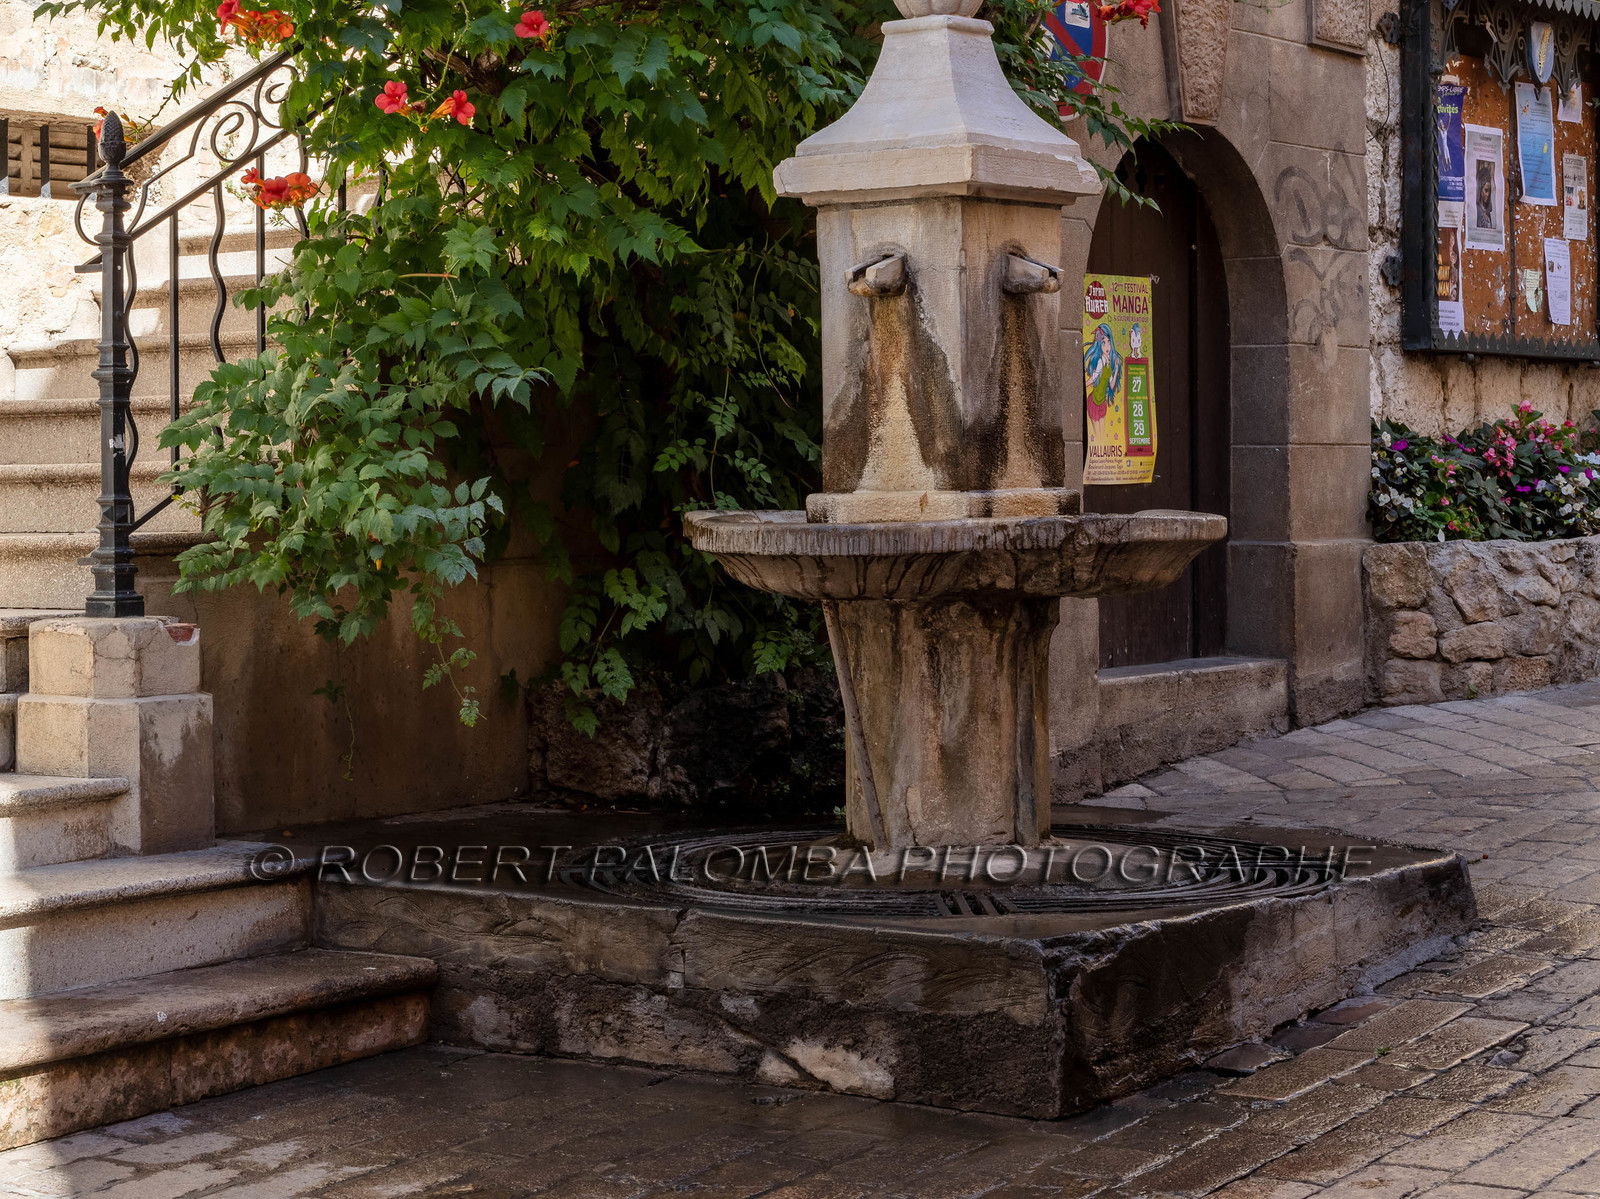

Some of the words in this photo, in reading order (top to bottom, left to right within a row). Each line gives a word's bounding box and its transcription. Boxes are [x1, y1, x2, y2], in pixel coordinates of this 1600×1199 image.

[1124, 283, 1149, 294] FESTIVAL
[1112, 294, 1149, 314] MANGA
[1132, 379, 1142, 393] 27
[1133, 403, 1144, 417] 28
[1133, 422, 1145, 436] 29
[1129, 437, 1151, 445] SEPTEMBRE
[1089, 445, 1123, 458] VALLAURIS
